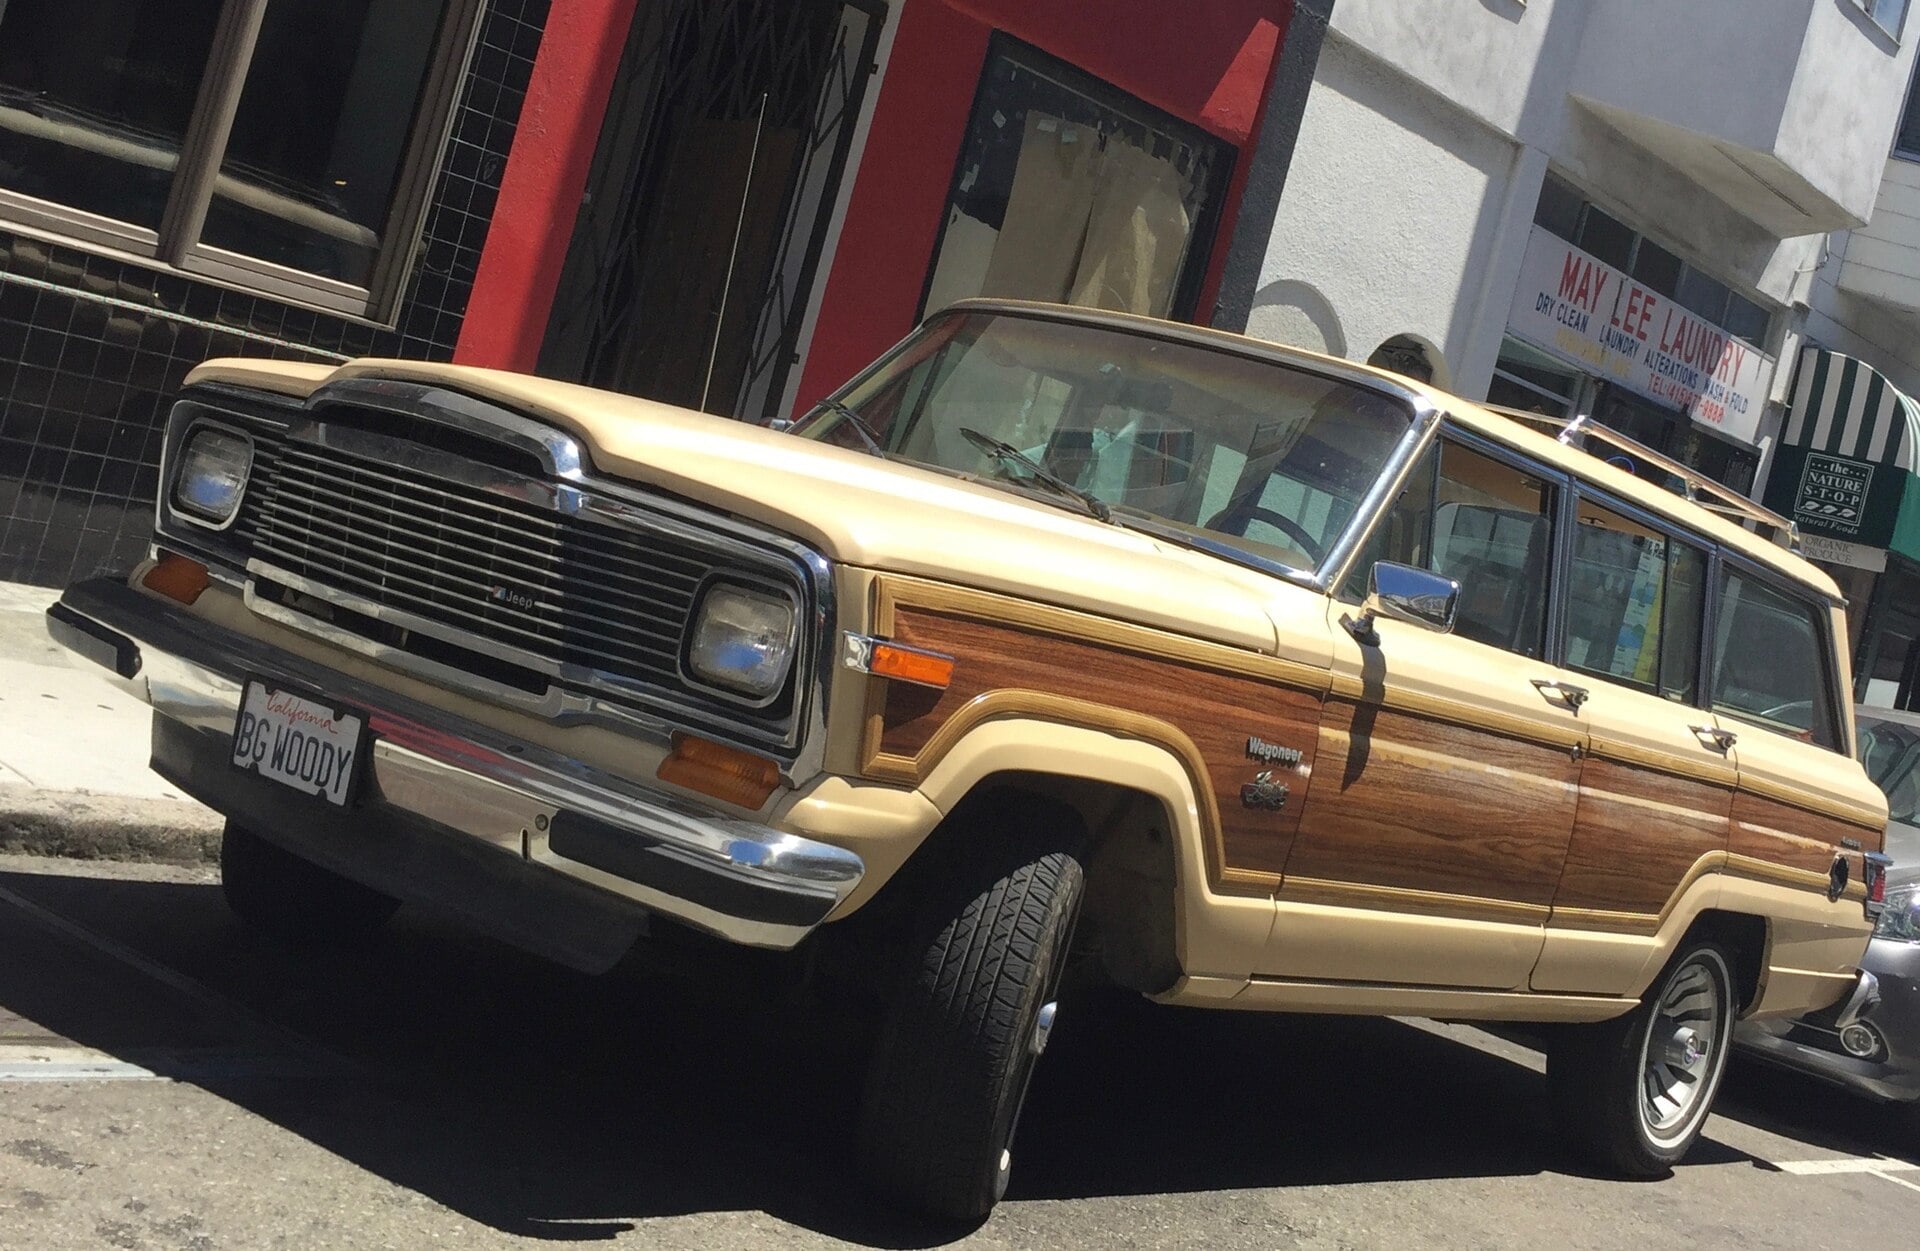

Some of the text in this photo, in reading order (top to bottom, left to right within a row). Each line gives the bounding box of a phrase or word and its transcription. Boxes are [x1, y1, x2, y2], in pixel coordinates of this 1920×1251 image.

[1557, 250, 1609, 315] MAY
[1610, 278, 1657, 342] LEE
[1659, 308, 1746, 388] LAUNDRY
[1535, 292, 1555, 319] DRY
[1557, 303, 1590, 334] CLEAN
[1599, 324, 1640, 361] LAUNDRY
[1643, 347, 1699, 390] ALTERATIONS
[1704, 376, 1725, 403] WASH
[1730, 392, 1748, 414] FOLD
[1829, 463, 1849, 475] the
[1807, 472, 1863, 493] NATURE
[1793, 514, 1858, 535] Natural Foods
[1803, 546, 1852, 564] PRODUCE
[1805, 536, 1854, 554] ORGANIC
[506, 591, 533, 610] Jeep
[266, 693, 338, 735] California
[236, 711, 352, 794] BG WOODY
[1248, 736, 1303, 762] Wagoneer
